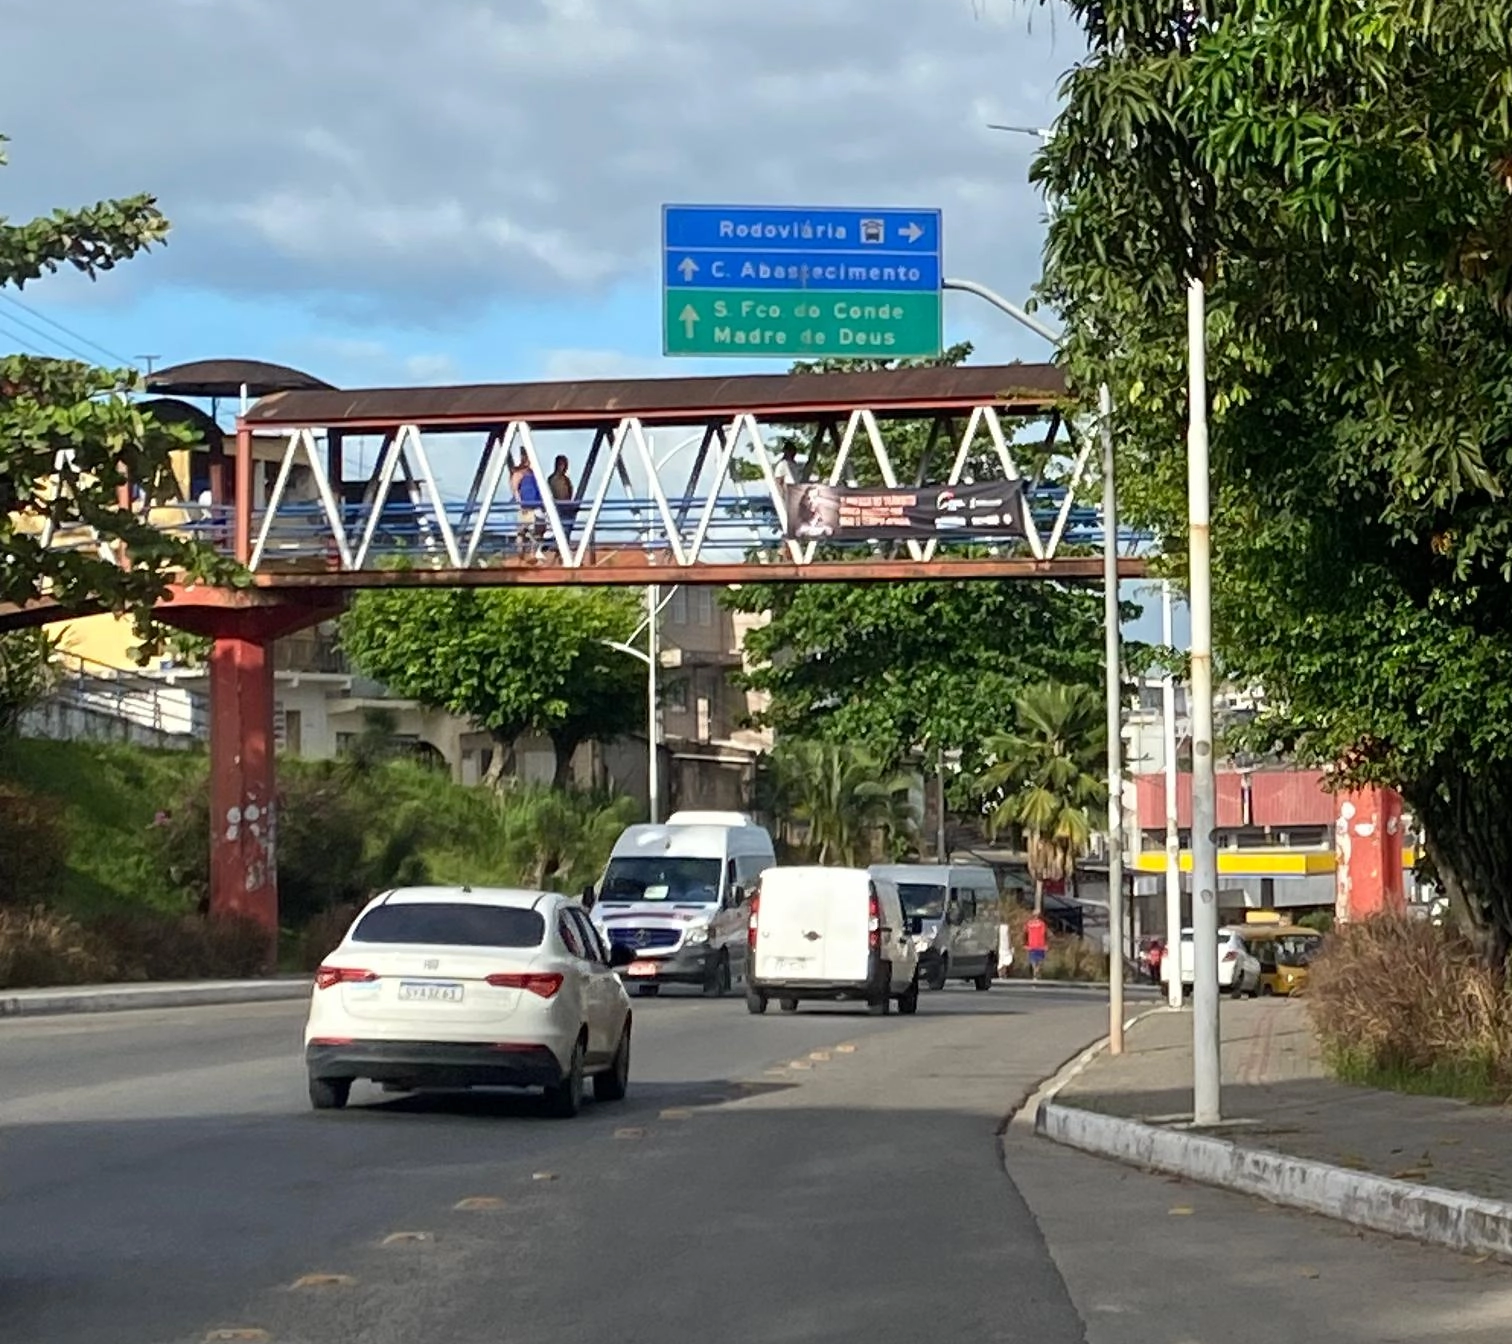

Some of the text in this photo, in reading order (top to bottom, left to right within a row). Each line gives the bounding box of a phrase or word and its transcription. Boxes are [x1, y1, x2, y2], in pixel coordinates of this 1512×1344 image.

[719, 220, 847, 240] Rodoviária
[711, 260, 920, 281] C. Abastecimento
[794, 301, 820, 318] do
[834, 302, 905, 320] Conde
[714, 326, 896, 346] Madre de Deus
